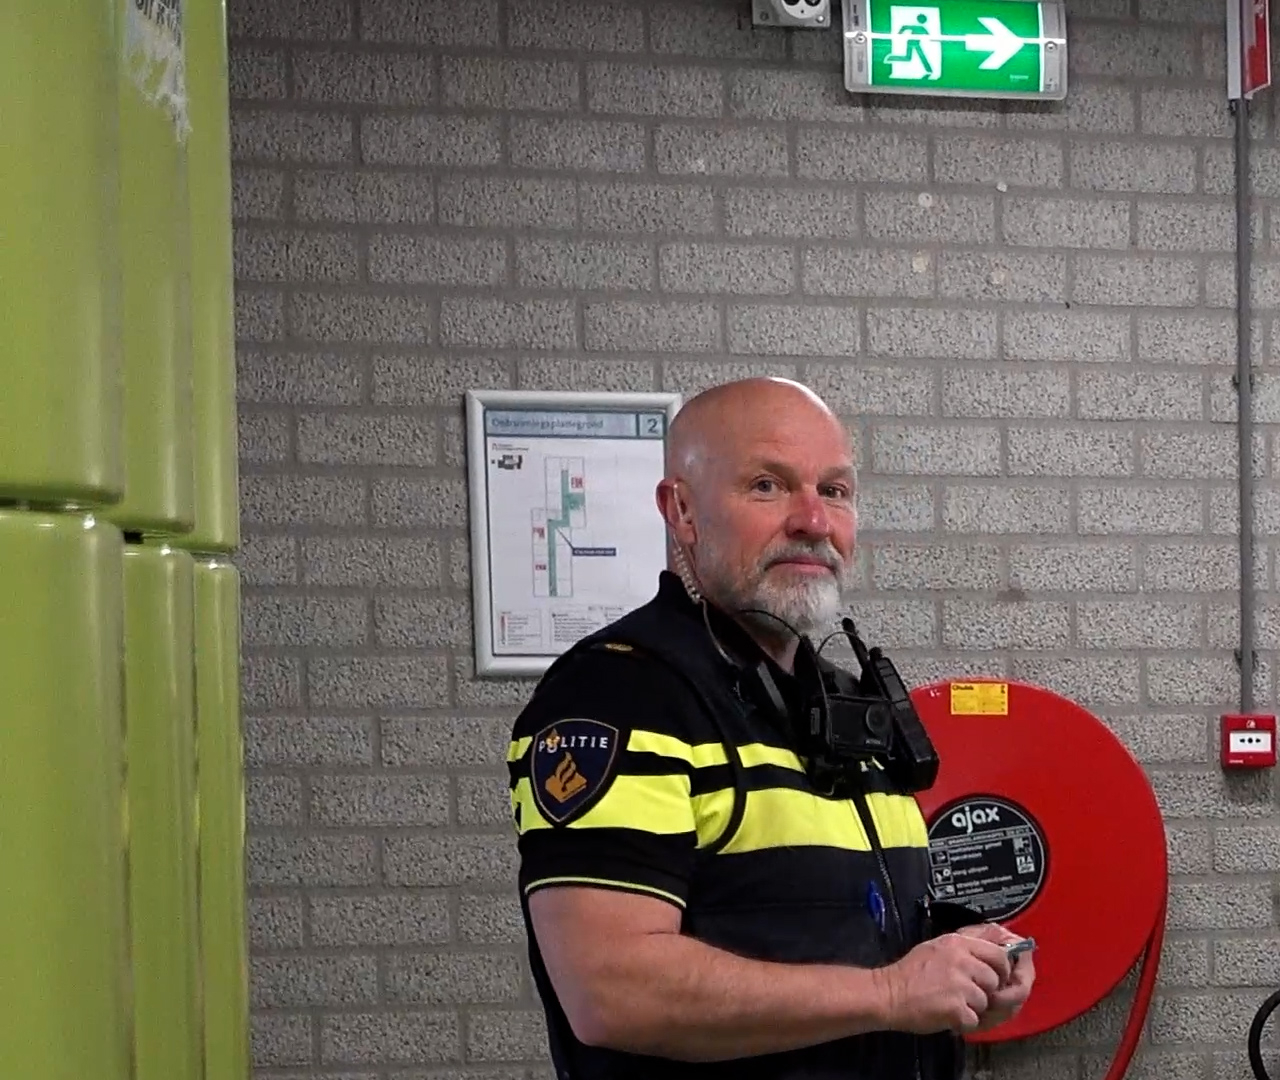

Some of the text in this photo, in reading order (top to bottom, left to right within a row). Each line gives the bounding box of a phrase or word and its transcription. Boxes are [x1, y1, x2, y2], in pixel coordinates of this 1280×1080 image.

[647, 418, 658, 433] 2
[539, 736, 609, 753] POLITIE
[952, 806, 999, 833] ajax
